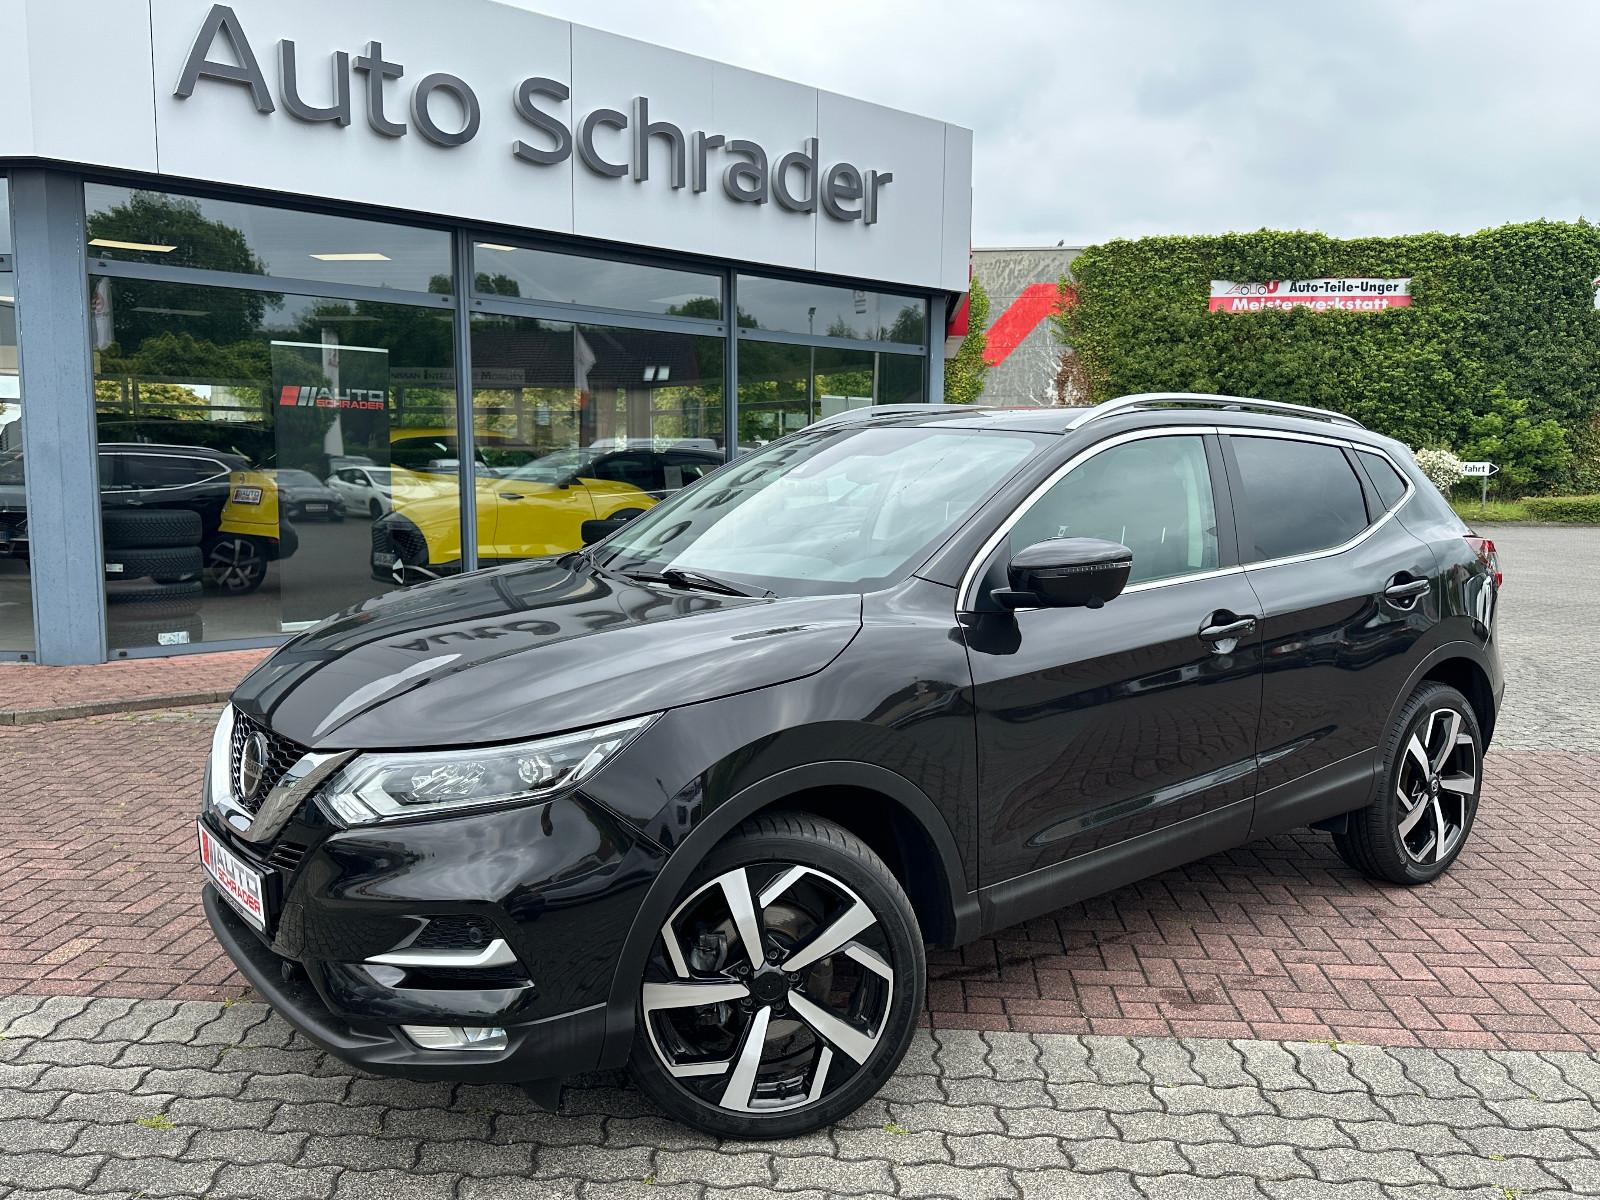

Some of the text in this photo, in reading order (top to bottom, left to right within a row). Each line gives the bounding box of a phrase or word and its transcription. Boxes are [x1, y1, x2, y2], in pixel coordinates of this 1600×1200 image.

[174, 3, 893, 224] Auto Schrader
[1289, 281, 1399, 294] Auto-Teile-Unger
[317, 387, 384, 401] AUTO
[316, 399, 384, 410] SCHRADER
[1462, 464, 1486, 473] fahrt
[217, 846, 260, 899] AUTO
[217, 865, 261, 915] SCHRADER
